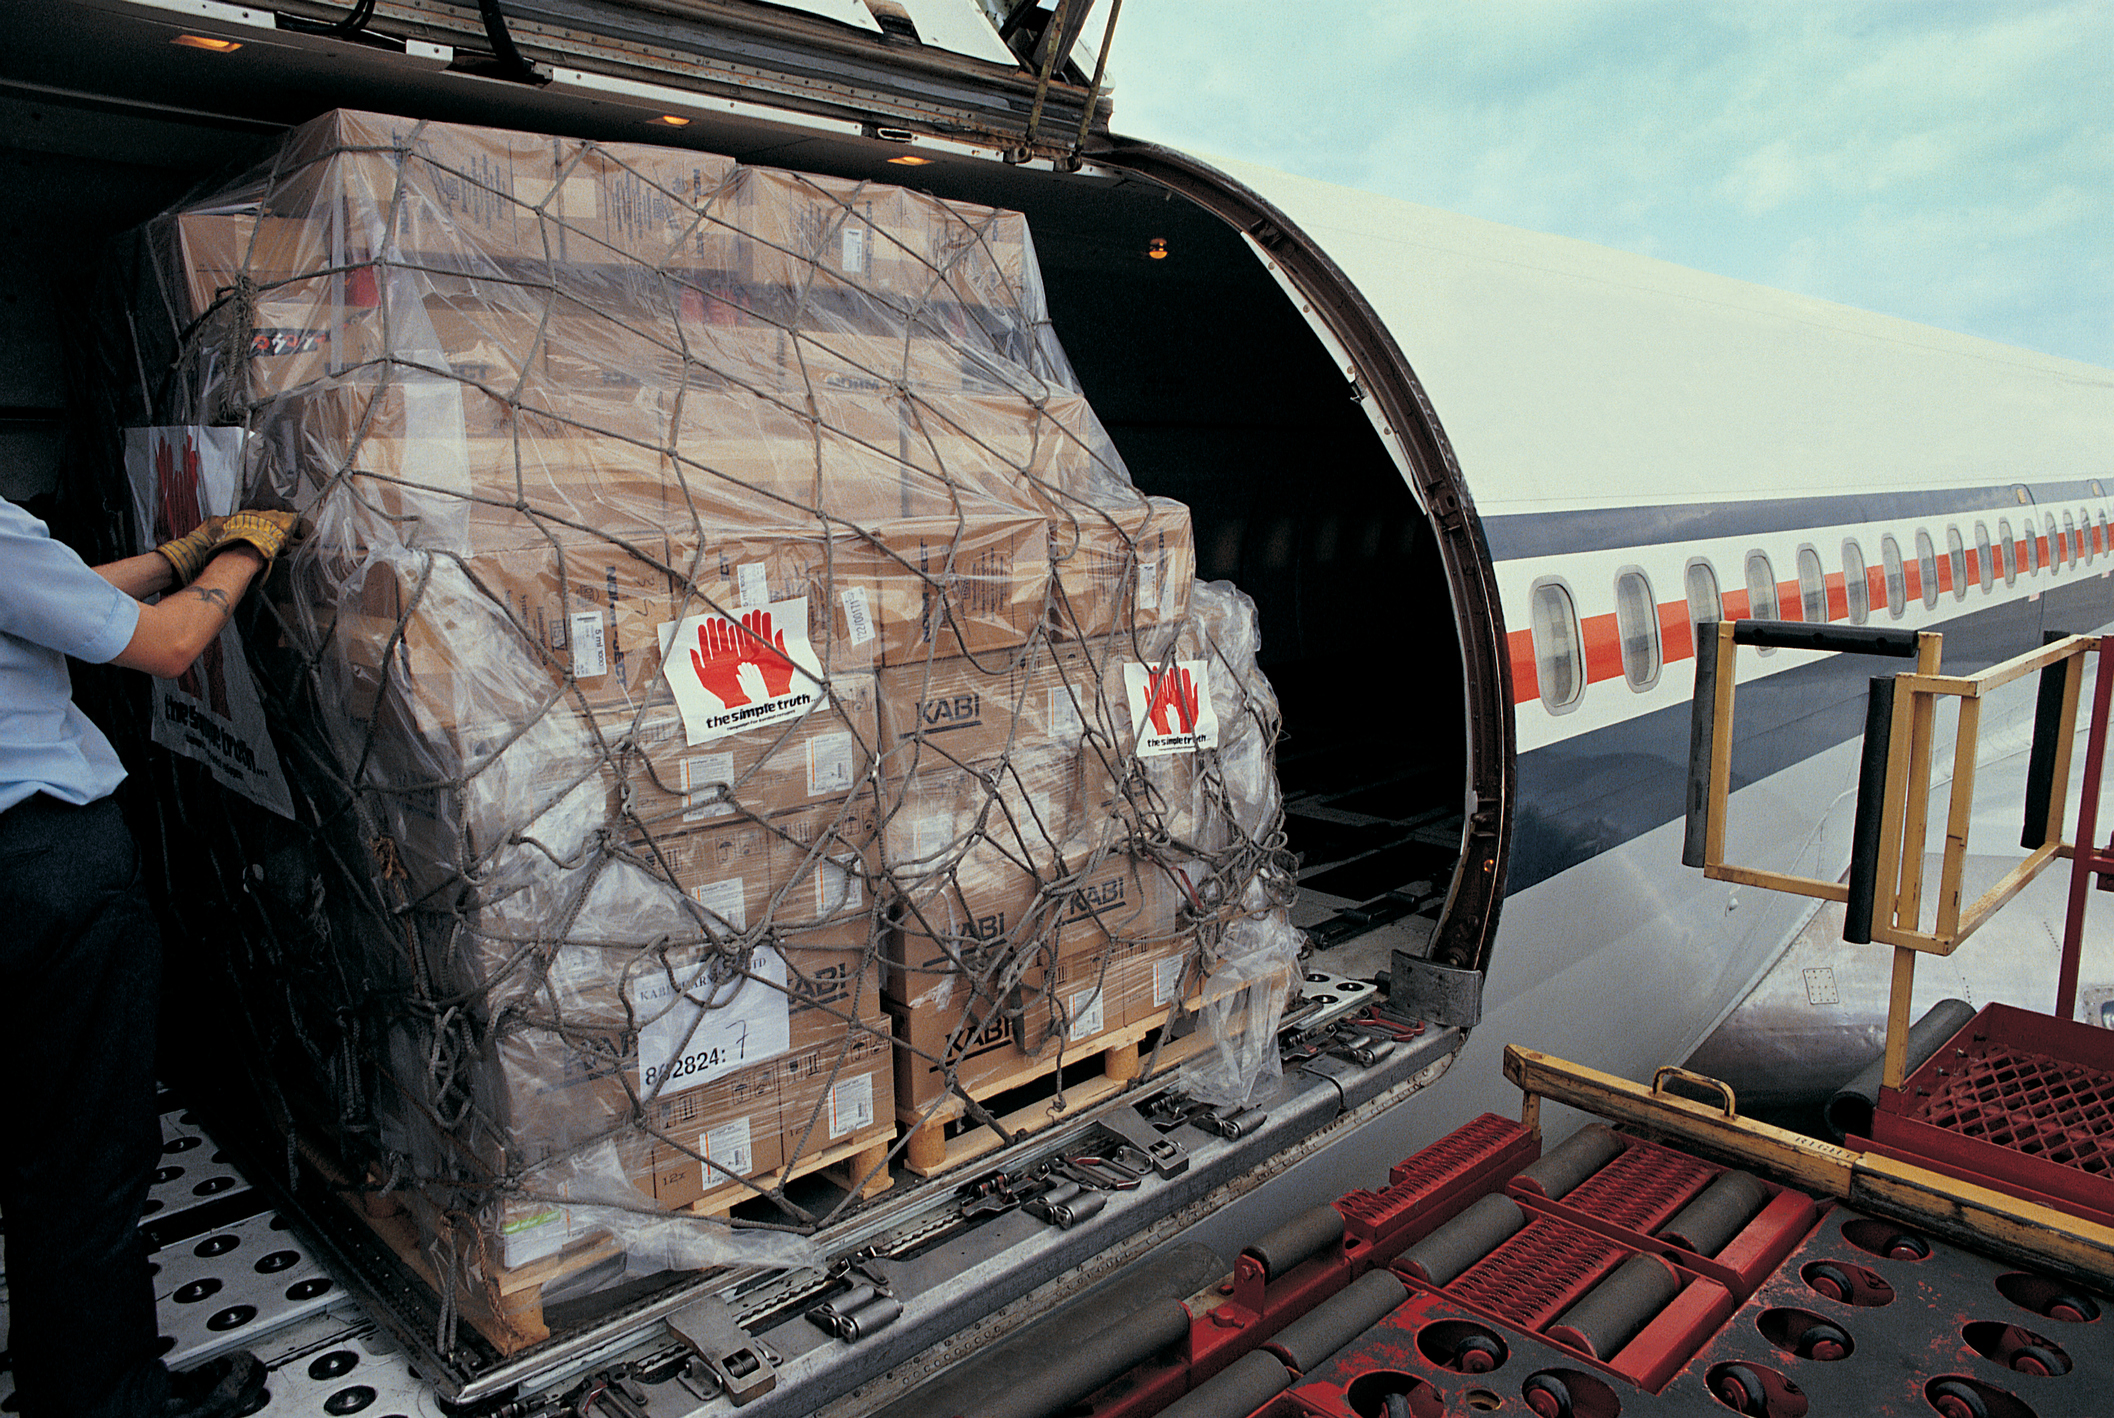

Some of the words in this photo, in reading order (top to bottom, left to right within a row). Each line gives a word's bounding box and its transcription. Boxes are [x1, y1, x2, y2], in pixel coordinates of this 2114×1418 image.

[921, 537, 930, 643] NORM-ECT
[596, 637, 604, 648] ml
[597, 651, 605, 667] 1000
[165, 693, 188, 726] the
[706, 714, 730, 729] the
[731, 703, 776, 723] simple
[915, 693, 980, 725] KABI
[1147, 739, 1160, 747] the
[1161, 736, 1183, 746] simple
[1070, 877, 1124, 915] KABI
[751, 957, 767, 970] TD
[725, 1019, 749, 1060] 7
[945, 1014, 1011, 1058] KABI
